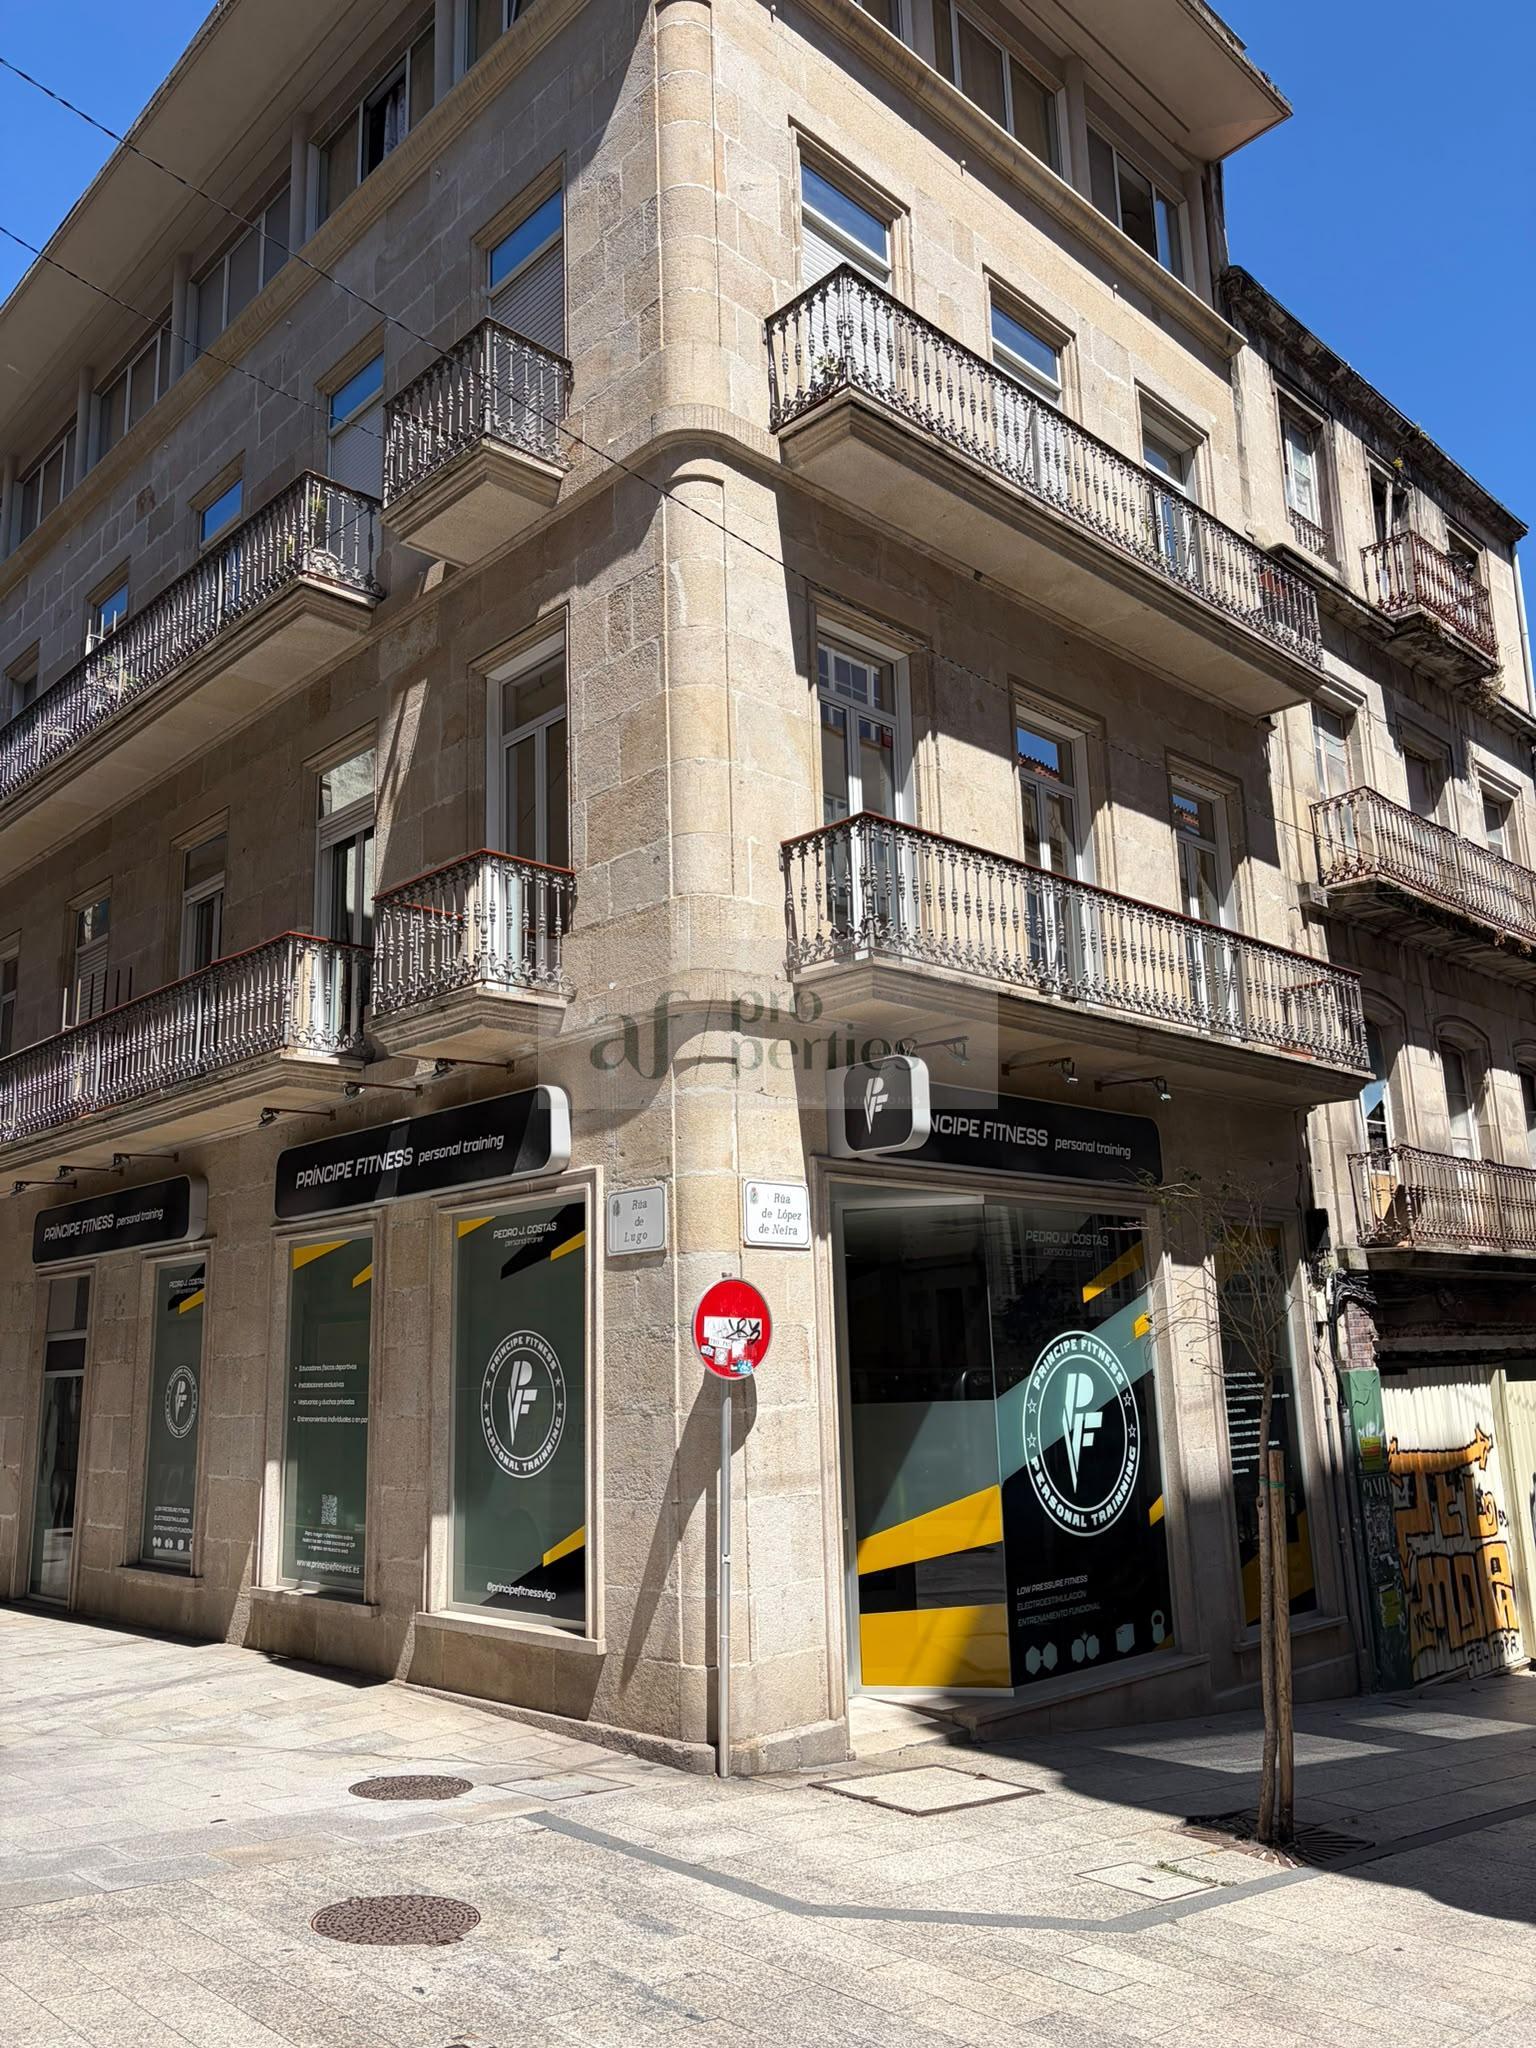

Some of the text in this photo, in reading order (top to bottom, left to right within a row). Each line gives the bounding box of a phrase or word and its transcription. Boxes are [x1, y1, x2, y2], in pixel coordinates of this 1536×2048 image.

[930, 1114, 1132, 1160] NCIPE FITNESS personal training
[354, 1147, 414, 1177] FITNESS
[417, 1140, 463, 1167] personal
[462, 1134, 505, 1153] training
[631, 1199, 648, 1210] Rúa
[773, 1192, 791, 1204] Rúa
[81, 1213, 115, 1235] FITNESS
[116, 1211, 142, 1229] personal
[634, 1216, 645, 1227] de
[761, 1207, 802, 1221] de López
[493, 1227, 518, 1240] PEDRO
[526, 1221, 558, 1234] COSTAS
[623, 1230, 648, 1244] Lugo
[758, 1223, 798, 1236] de Neira
[1025, 1230, 1059, 1244] PEDRO
[1072, 1233, 1109, 1247] COSTAS
[489, 1335, 558, 1373] PRINCIPE FITNESS
[1032, 1338, 1125, 1391] PRINCIPE FITNESS
[484, 1416, 562, 1472] PERSONAL TRAINNING
[1030, 1446, 1137, 1528] PERSONAL TRAINNING
[486, 1581, 557, 1602] @principefitnessvigo
[1016, 1574, 1088, 1596] LOW PRESSURE FITNESS
